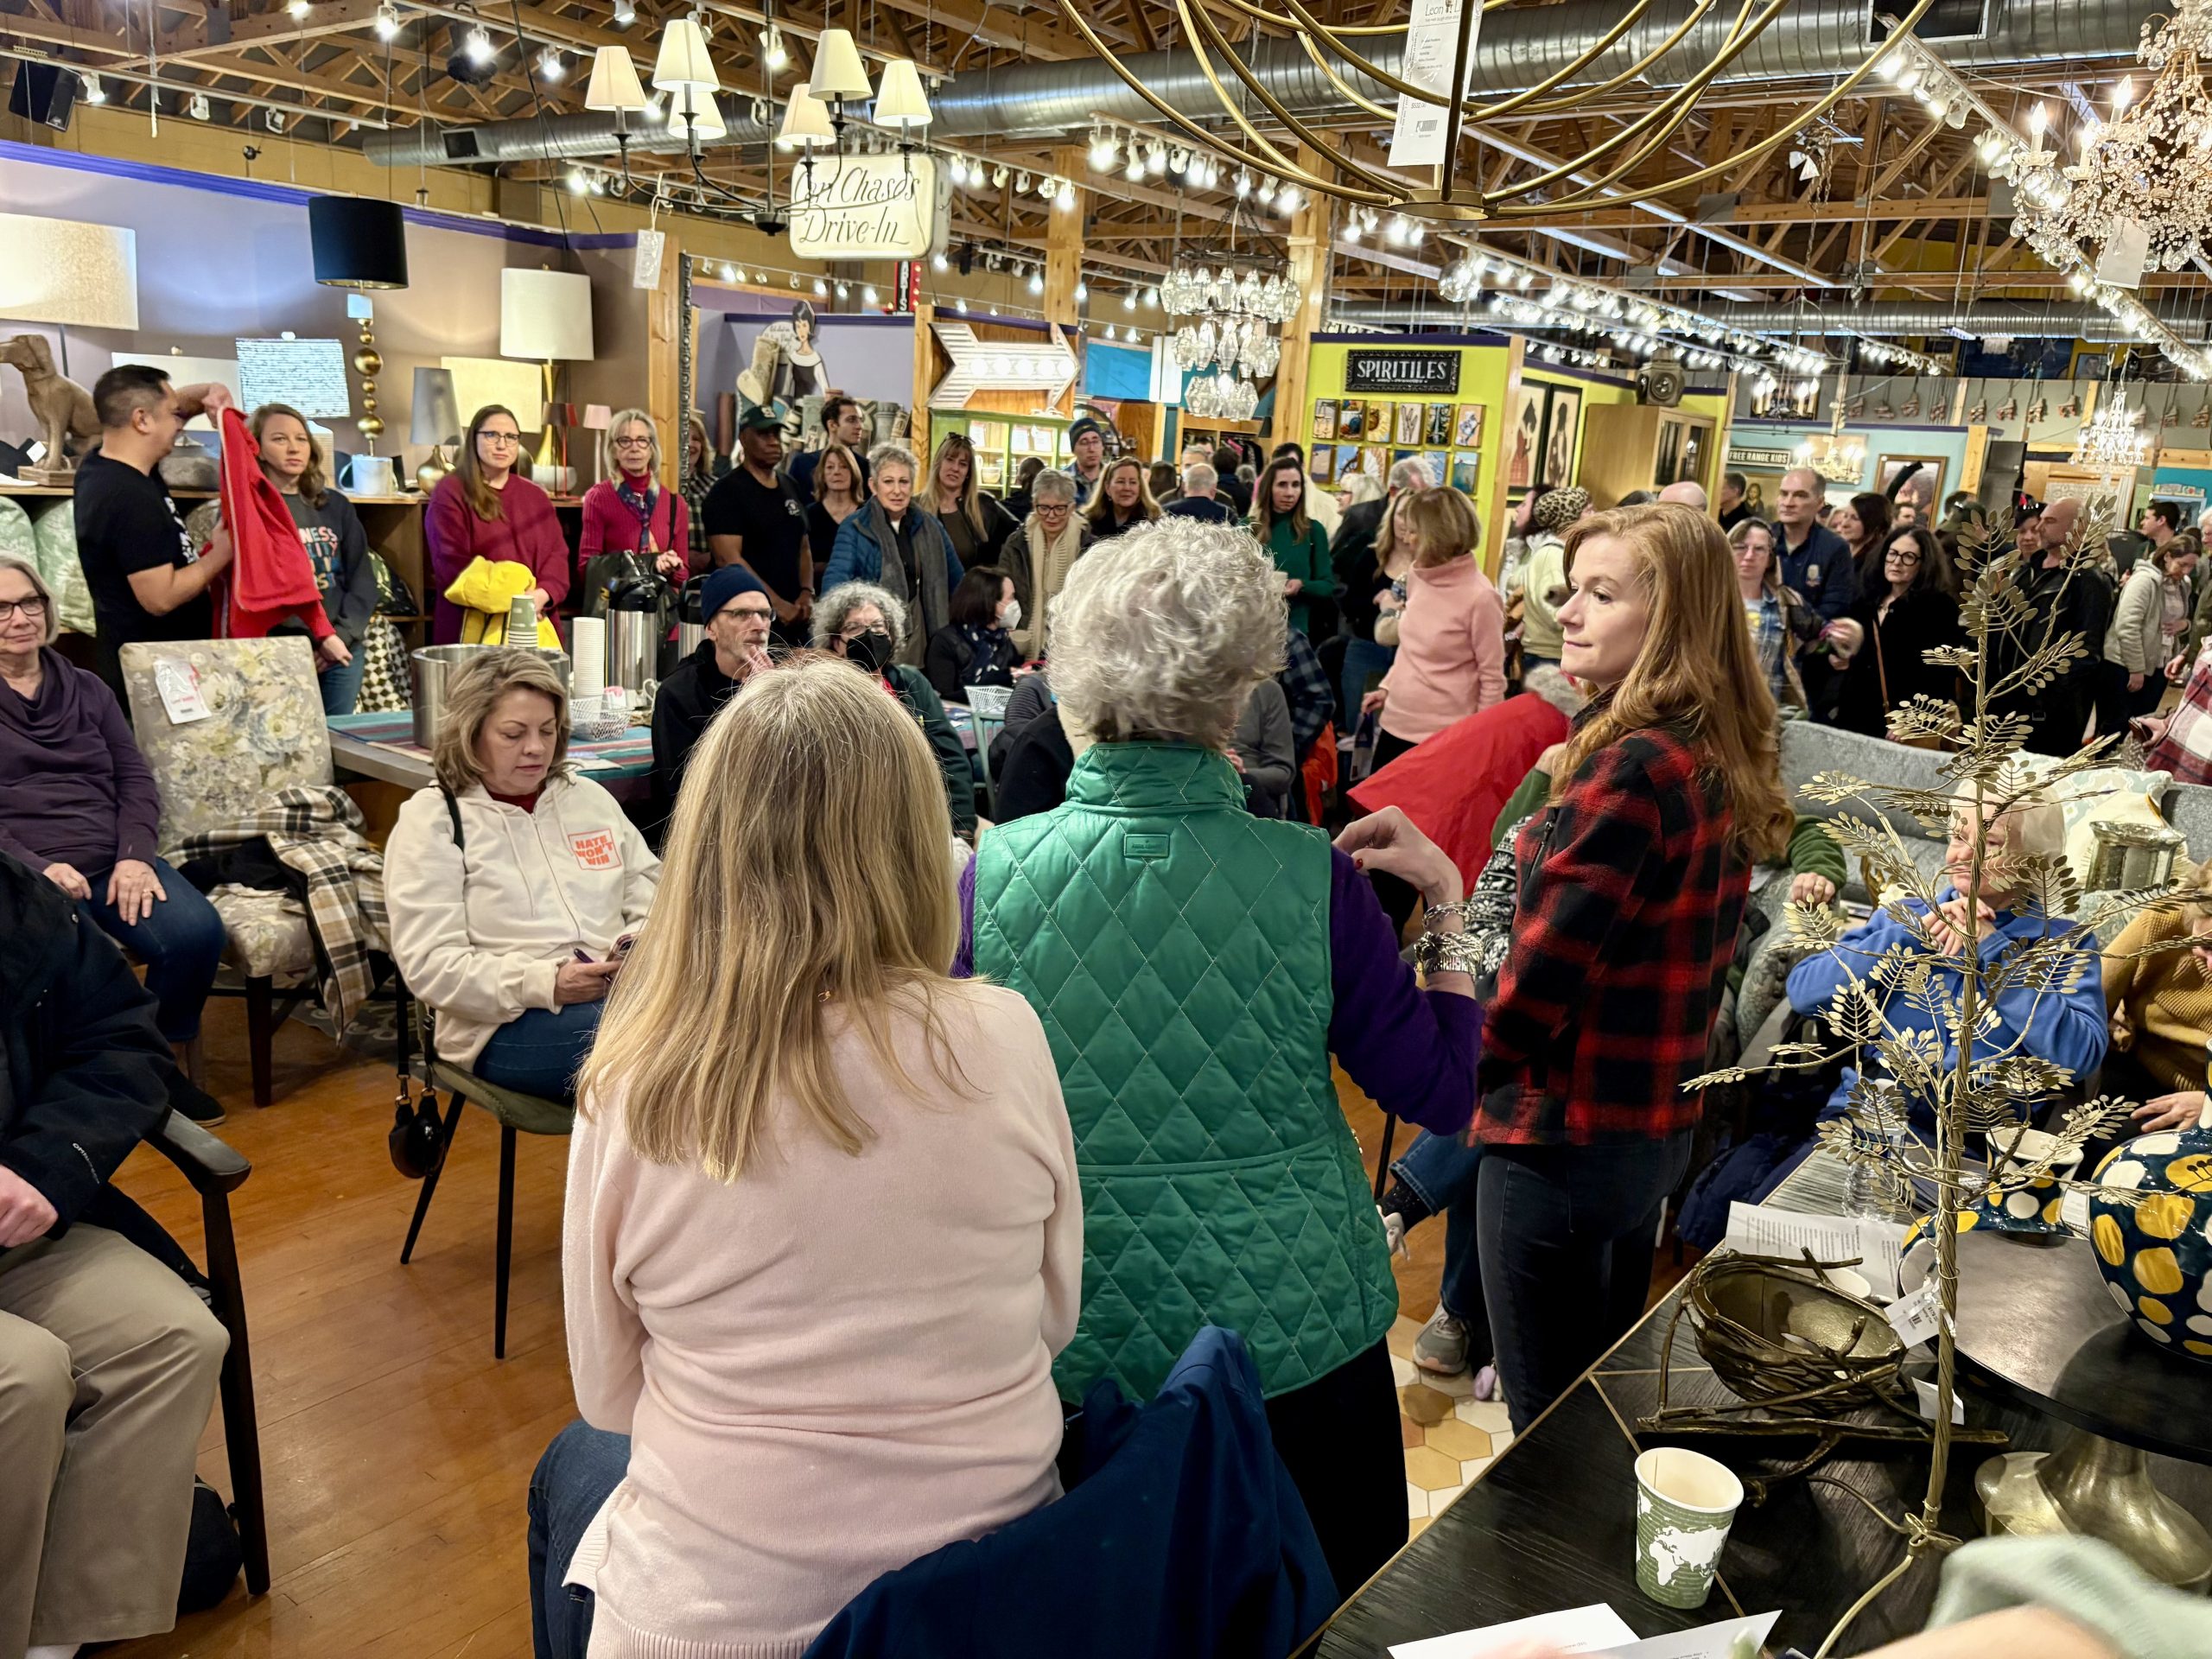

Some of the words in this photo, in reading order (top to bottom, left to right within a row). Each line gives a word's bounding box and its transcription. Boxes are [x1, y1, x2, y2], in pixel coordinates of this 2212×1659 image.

[1425, 3, 1444, 16] Leon
[799, 206, 910, 245] Drive-In
[1357, 359, 1447, 379] SPIRITILES
[1728, 450, 1745, 461] FREE
[1746, 452, 1770, 462] RANGE
[1770, 454, 1788, 464] KIDS
[575, 835, 607, 849] HATE
[575, 842, 613, 858] WON'T
[586, 854, 610, 865] WIN
